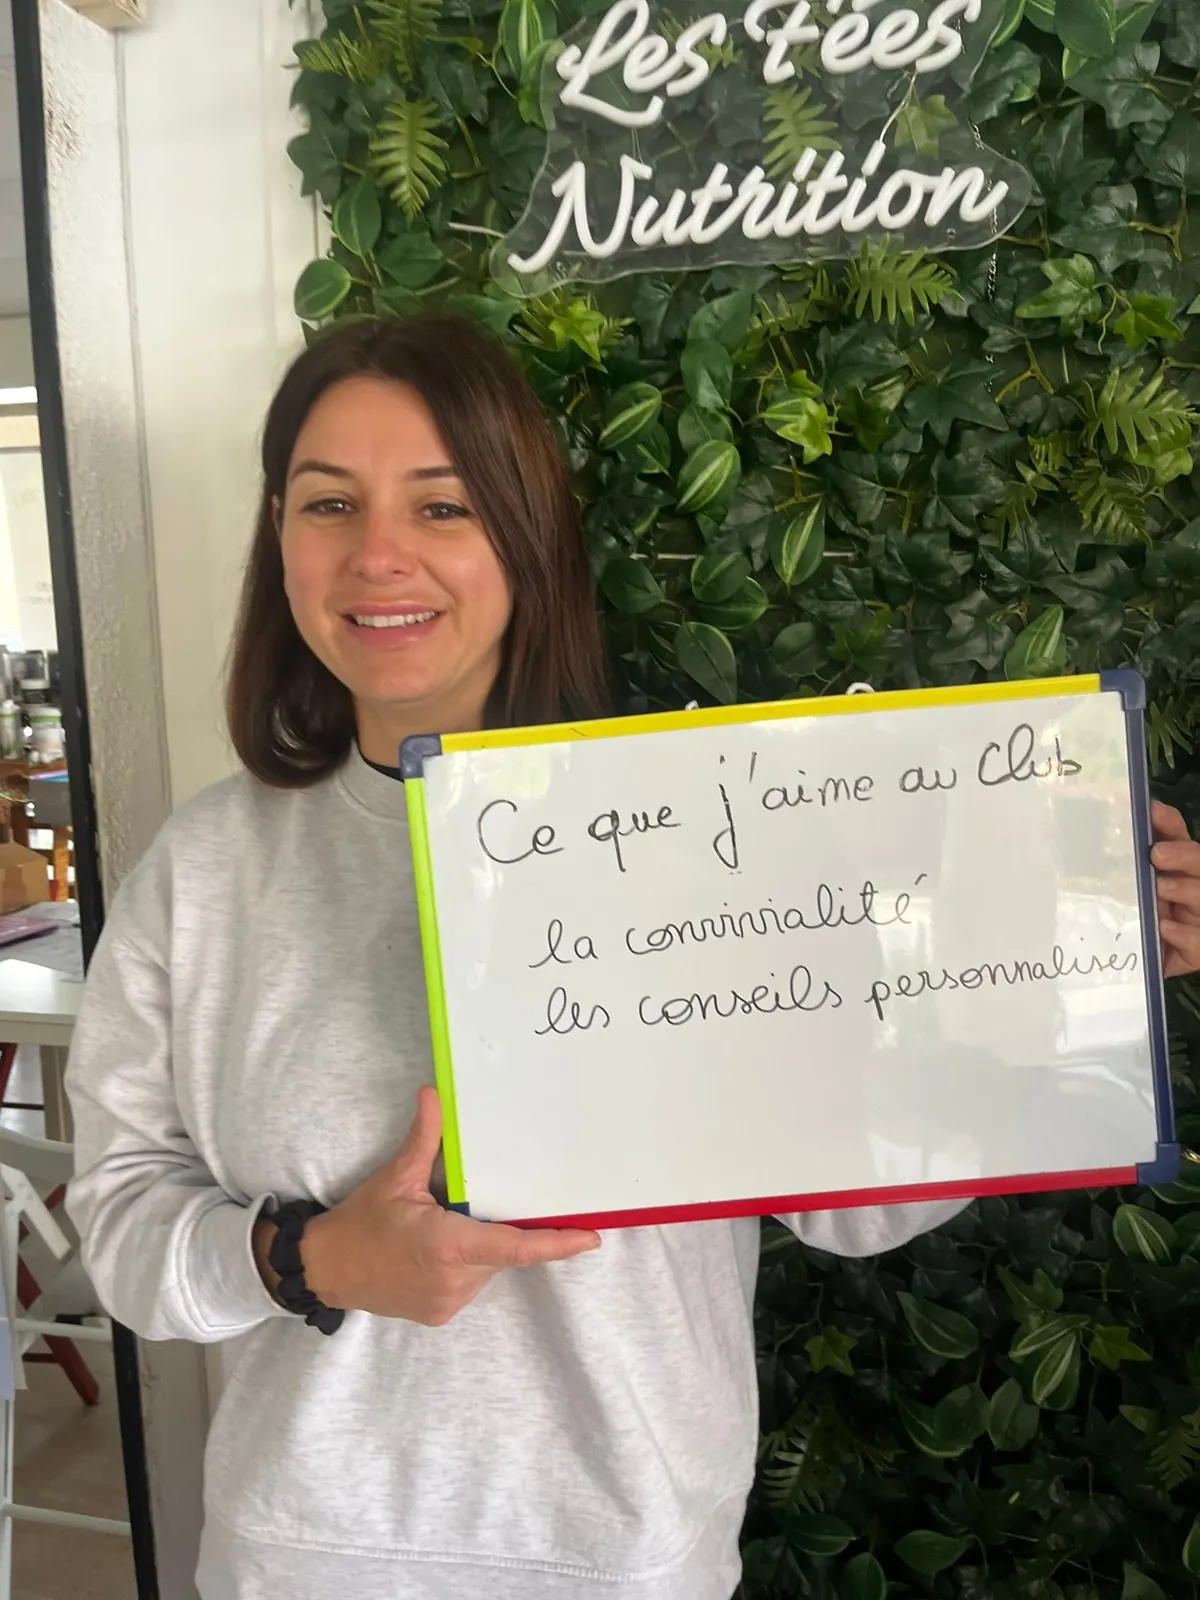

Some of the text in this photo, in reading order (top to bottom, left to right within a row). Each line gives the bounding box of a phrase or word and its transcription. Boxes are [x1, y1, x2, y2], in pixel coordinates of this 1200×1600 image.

[556, 0, 726, 127] Les
[507, 141, 1009, 273] Nutrition
[477, 799, 564, 864] Ce
[587, 805, 682, 873] que
[712, 750, 874, 870] j'aime
[899, 766, 957, 792] au
[528, 873, 928, 968] la convivialité
[534, 932, 1138, 1035] les conseils personnalisés
